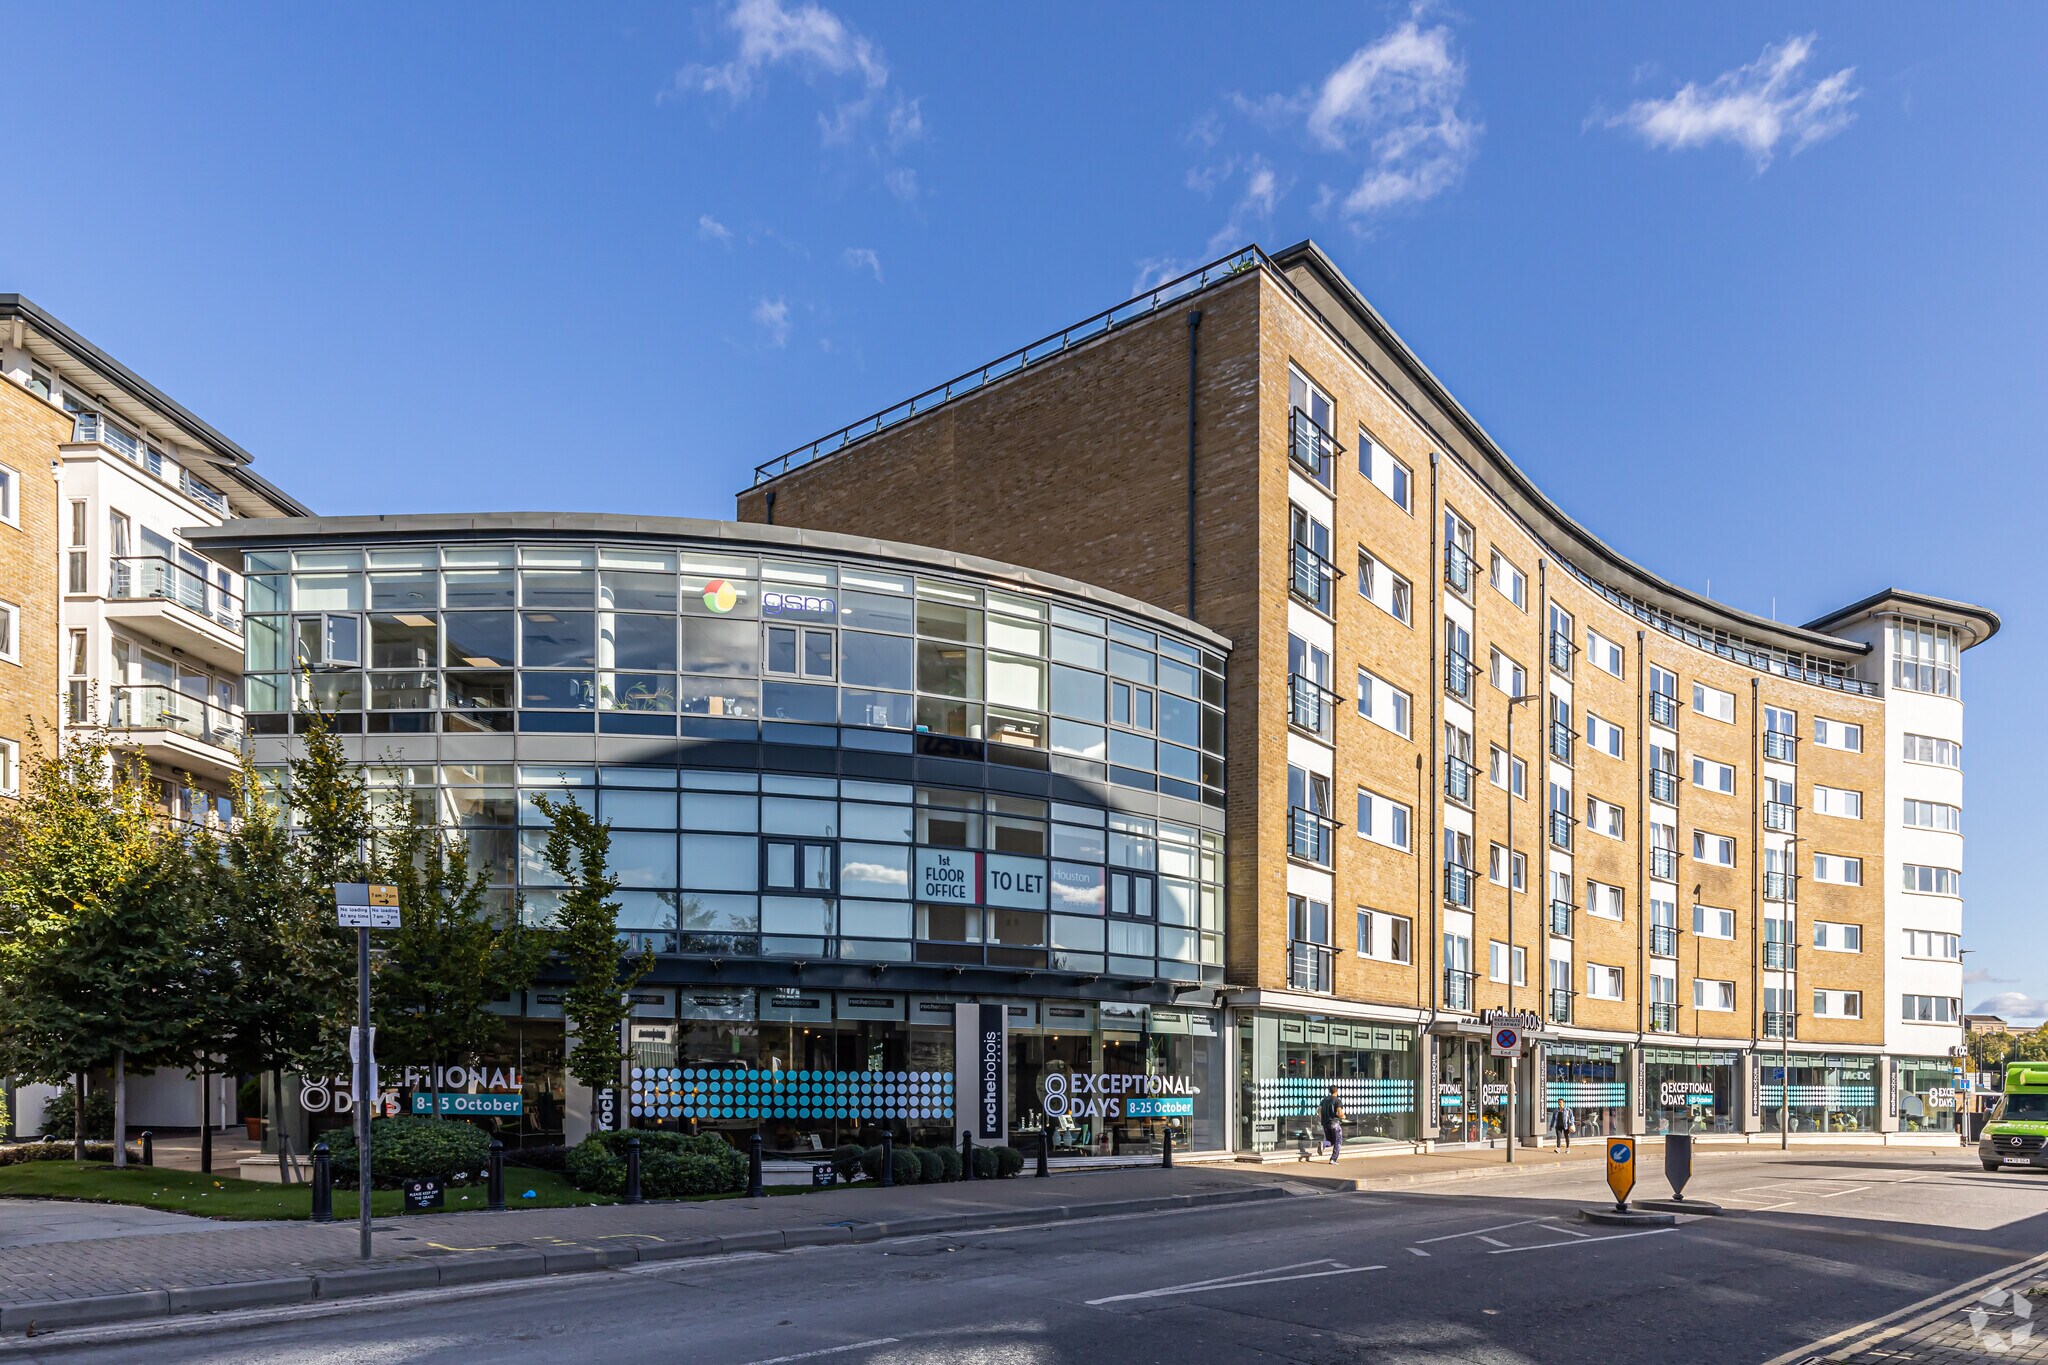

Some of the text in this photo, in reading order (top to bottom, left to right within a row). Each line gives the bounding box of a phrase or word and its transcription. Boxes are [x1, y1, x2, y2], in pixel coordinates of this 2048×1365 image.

[764, 592, 836, 615] gsm
[938, 854, 950, 866] 1st
[926, 867, 964, 883] FLOOR
[991, 870, 1012, 890] TO
[1017, 873, 1043, 893] LET
[1053, 868, 1090, 882] Houston
[926, 883, 966, 899] OFFICE
[984, 1031, 996, 1132] rochebobois
[1071, 1073, 1193, 1095] EXCEPTIONAL
[1668, 1082, 1713, 1094] EXCEPTIONAL
[334, 1091, 401, 1114] DYS
[1044, 1073, 1068, 1118] 8
[1661, 1082, 1669, 1105] 8
[1668, 1094, 1685, 1105] DAYS
[1929, 1087, 1939, 1107] 8
[454, 1097, 519, 1111] October
[1071, 1097, 1120, 1118] DAYS
[1129, 1101, 1191, 1114] 8-25 October
